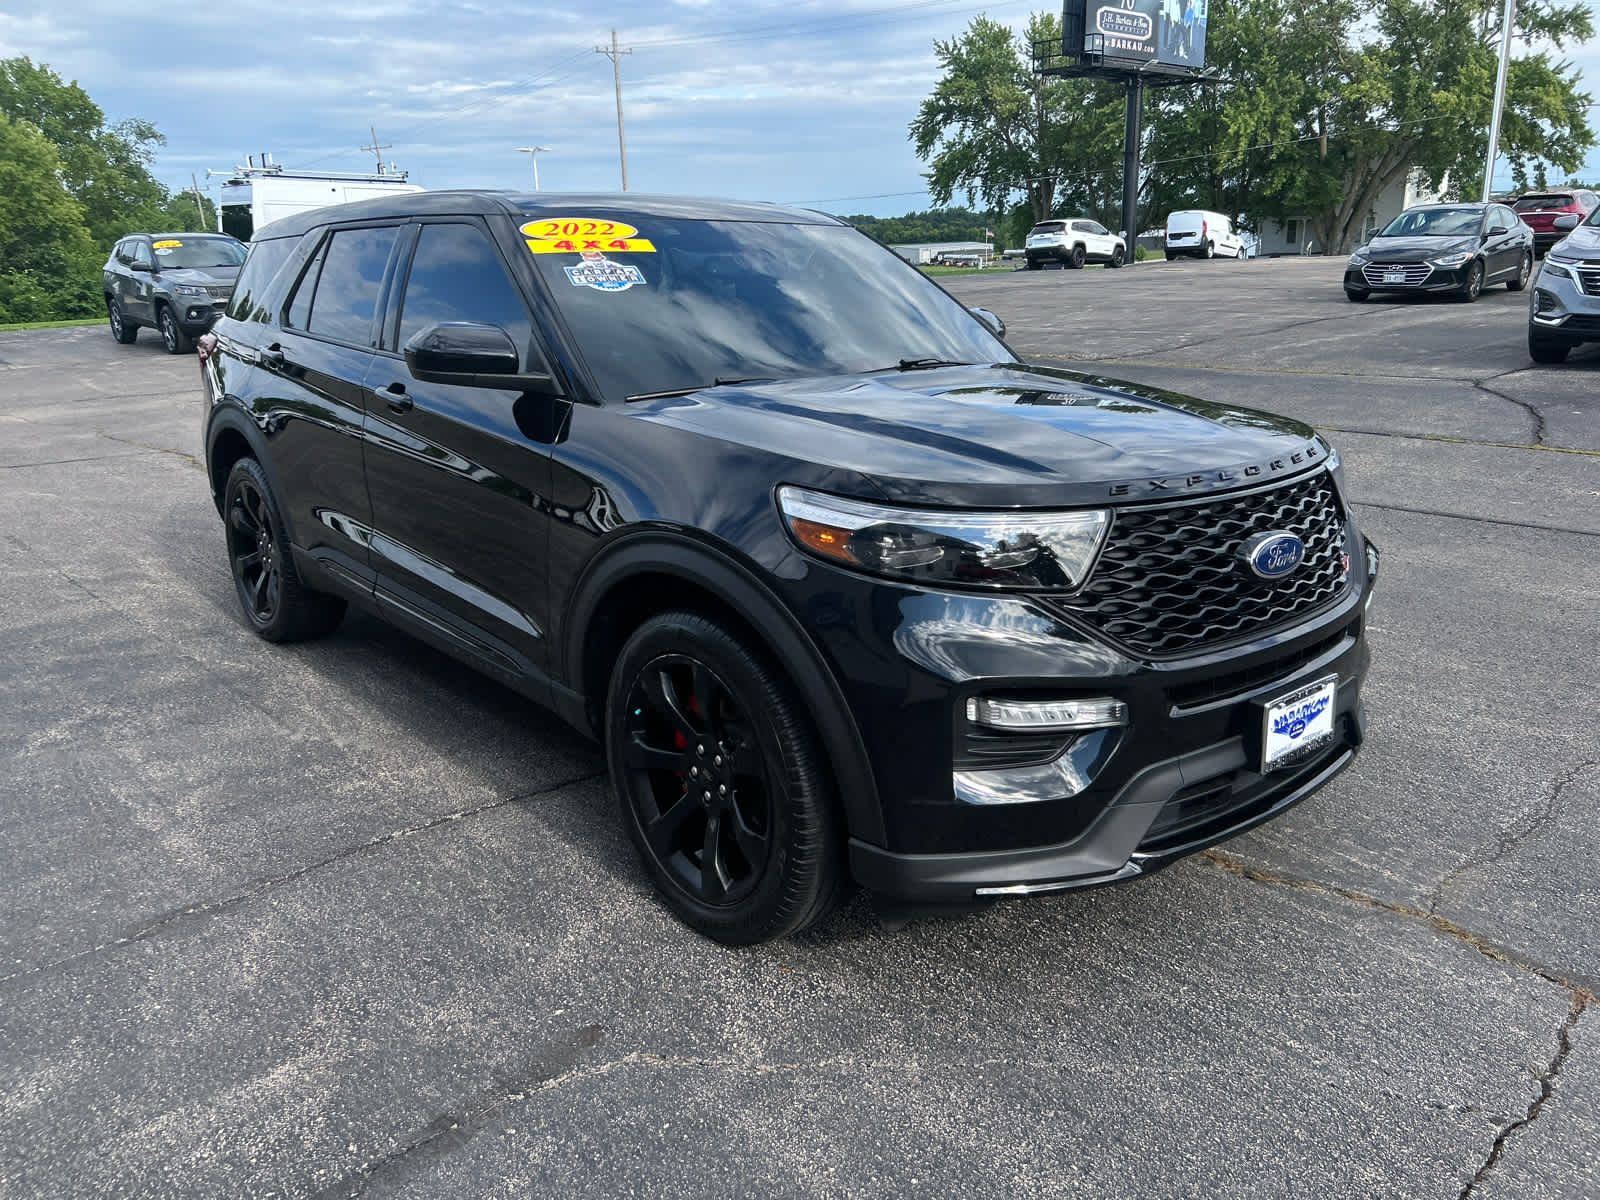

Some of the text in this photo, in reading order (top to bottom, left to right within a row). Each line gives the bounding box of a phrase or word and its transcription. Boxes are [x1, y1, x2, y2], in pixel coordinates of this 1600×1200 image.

[543, 222, 616, 236] 2022
[571, 267, 638, 276] CARFAX
[1108, 447, 1319, 497] EXPLORER
[1267, 543, 1298, 570] Ford
